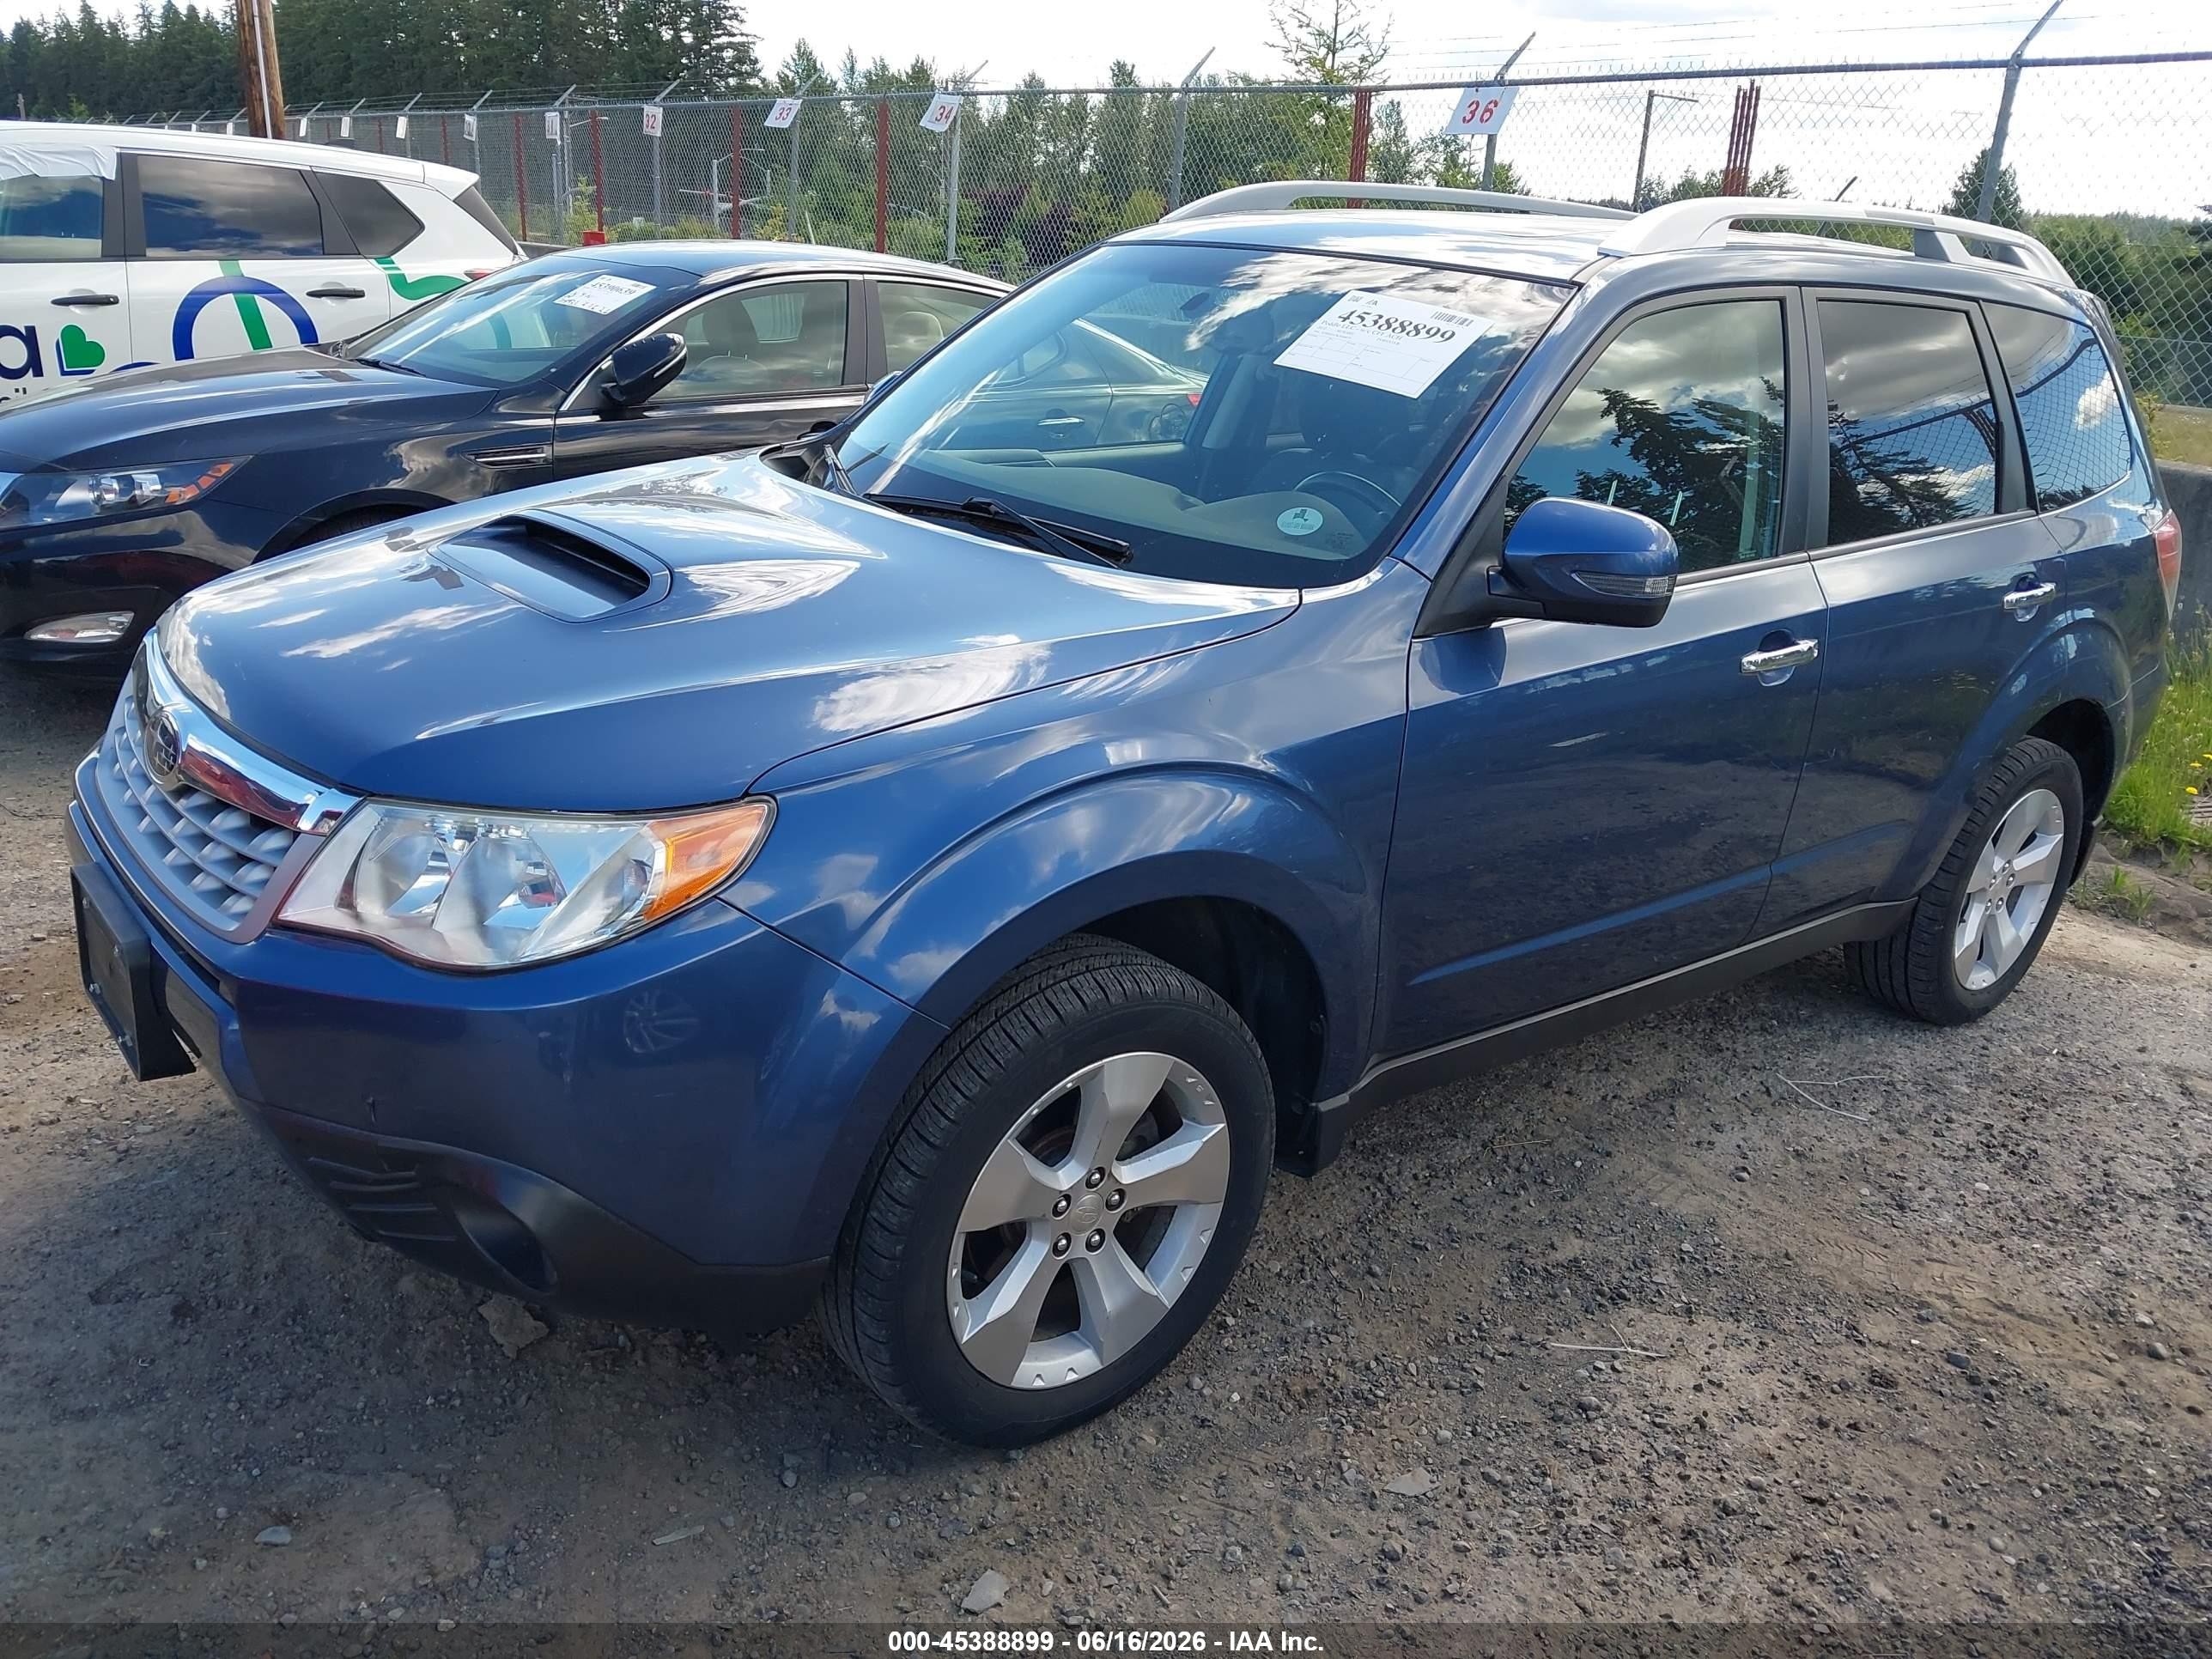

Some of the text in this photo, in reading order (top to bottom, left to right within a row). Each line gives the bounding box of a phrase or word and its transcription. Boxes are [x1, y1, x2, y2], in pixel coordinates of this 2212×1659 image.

[775, 106, 792, 121] 33
[935, 105, 953, 124] 34
[1462, 99, 1498, 124] 36
[1337, 308, 1456, 343] 45388899
